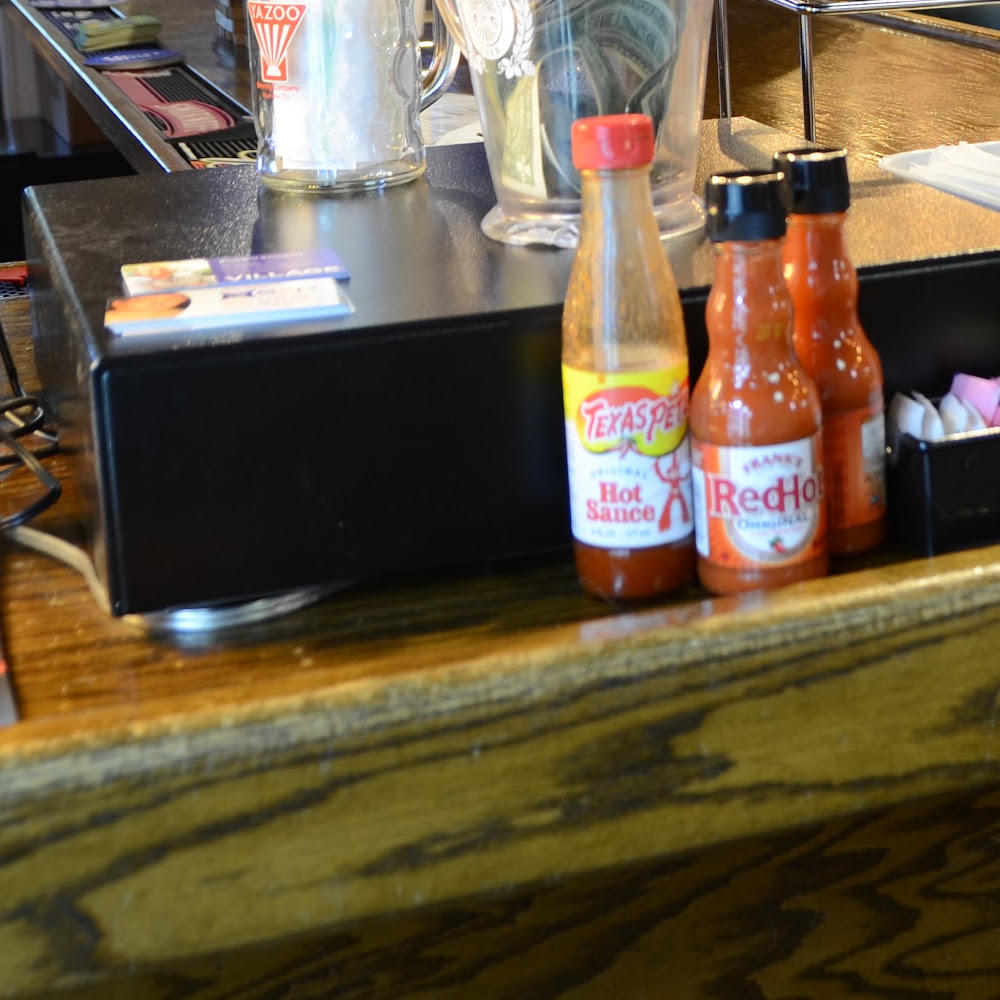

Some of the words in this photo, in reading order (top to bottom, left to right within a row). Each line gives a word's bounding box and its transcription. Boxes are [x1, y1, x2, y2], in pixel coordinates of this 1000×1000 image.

[250, 3, 301, 21] YAZOO
[583, 400, 648, 440] TEXAS
[599, 481, 643, 503] Hot
[586, 498, 656, 523] Sauce
